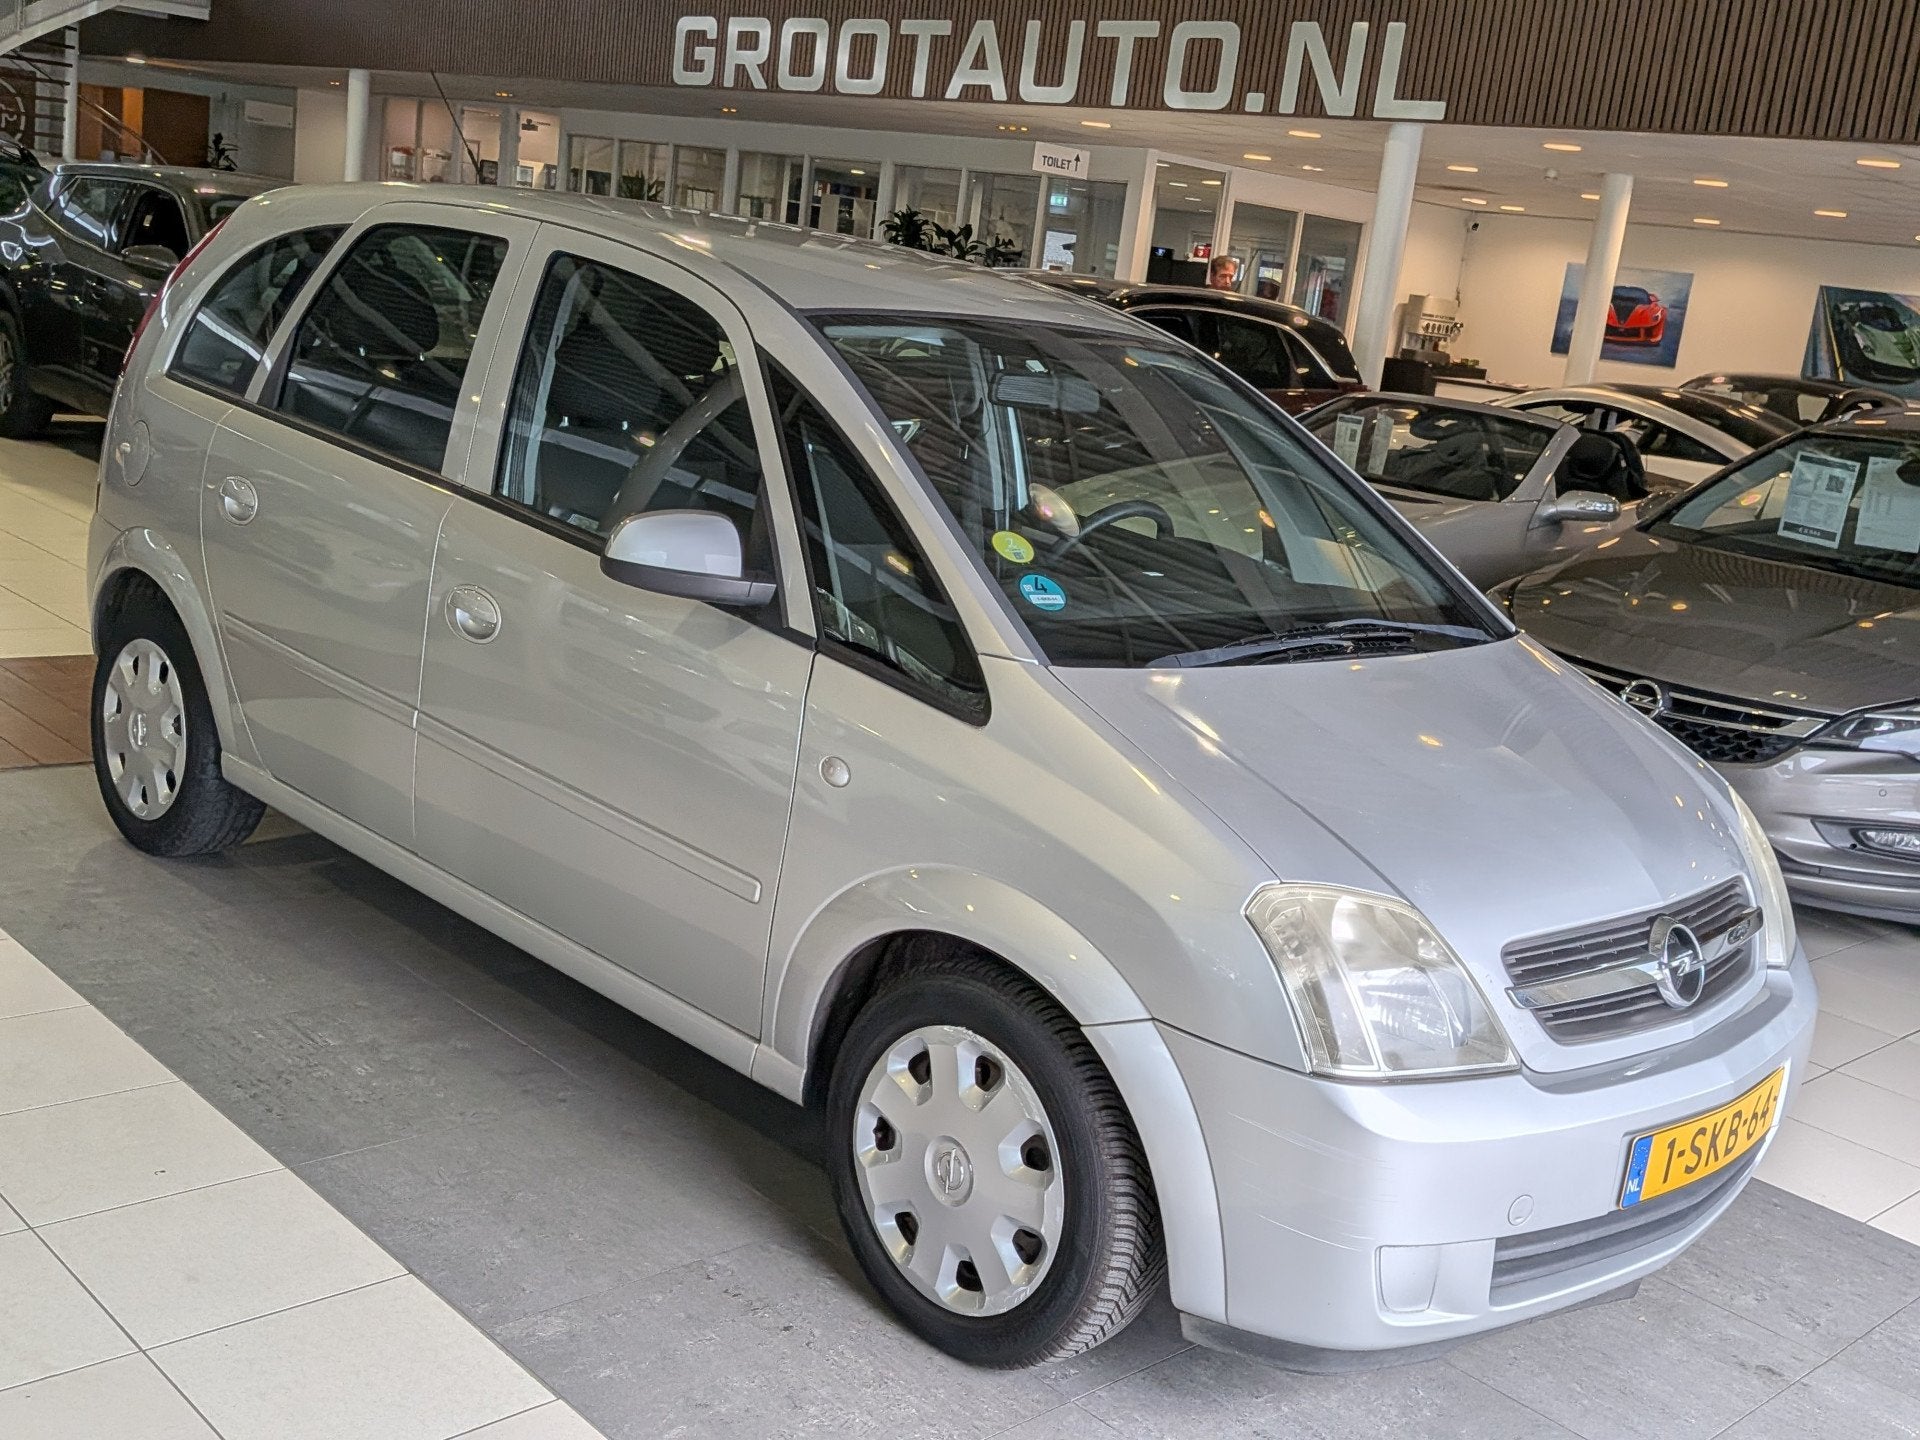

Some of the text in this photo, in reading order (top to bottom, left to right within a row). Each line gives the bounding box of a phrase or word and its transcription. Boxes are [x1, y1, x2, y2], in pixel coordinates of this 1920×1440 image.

[673, 16, 1447, 120] GROOTAUTO.NL
[1042, 155, 1072, 171] TOILET
[1034, 576, 1048, 593] 4
[1662, 1085, 1774, 1184] 1-SKB-64
[1626, 1177, 1640, 1195] NL
